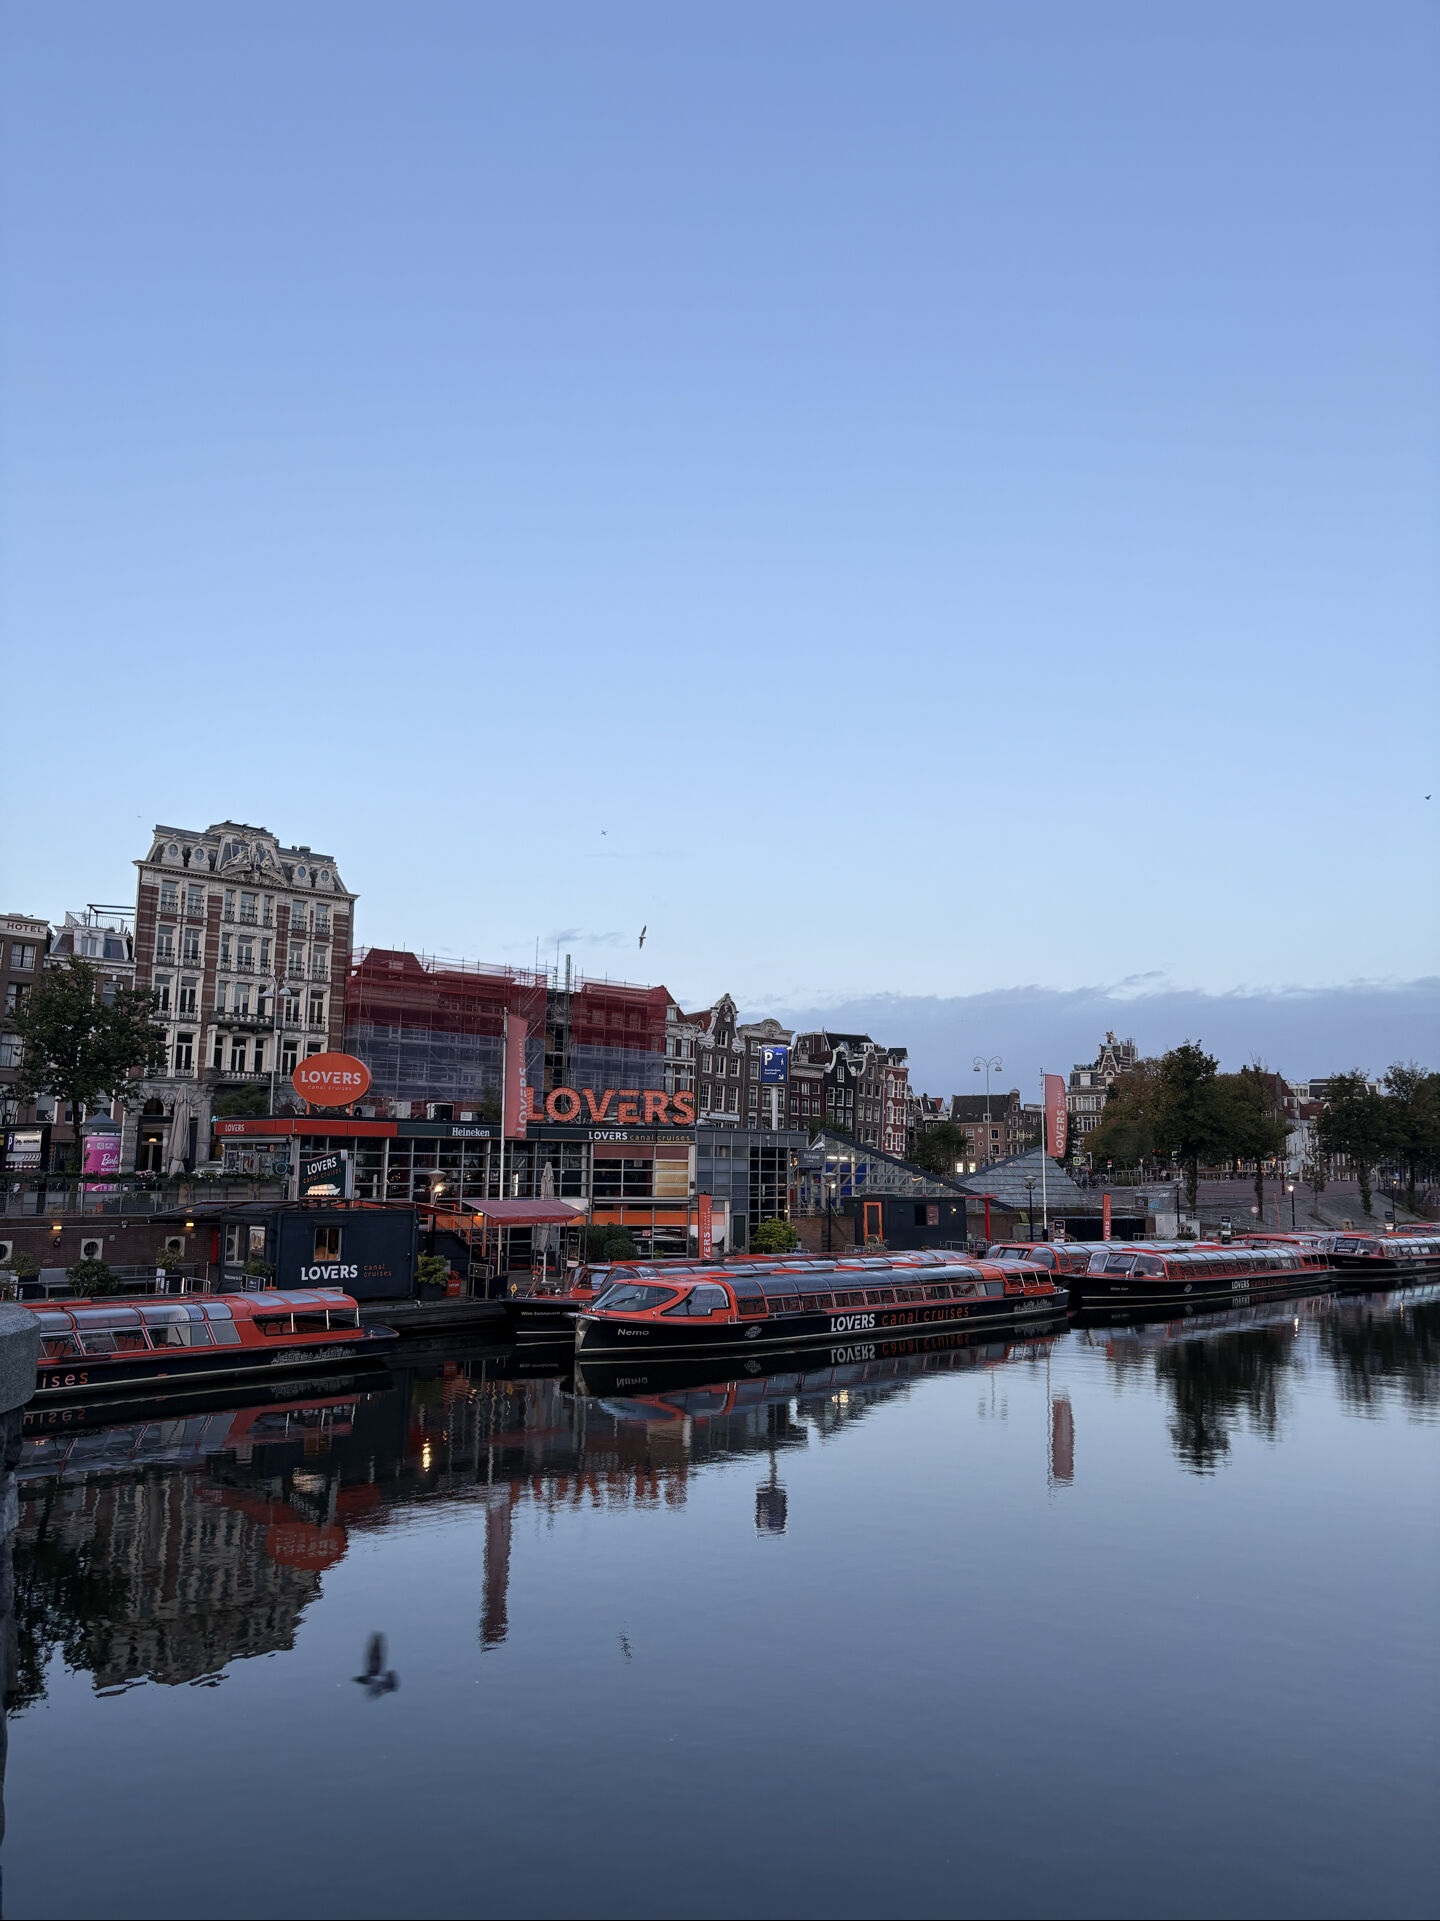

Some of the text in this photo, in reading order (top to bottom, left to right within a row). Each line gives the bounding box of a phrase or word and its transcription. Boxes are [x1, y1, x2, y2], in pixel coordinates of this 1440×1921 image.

[7, 922, 44, 934] HOTEL
[764, 1052, 774, 1066] P
[300, 1071, 362, 1086] LOVERS
[516, 1067, 528, 1133] LOVERS
[526, 1085, 697, 1126] LOVERS
[224, 1123, 245, 1132] LOVERS
[452, 1127, 490, 1137] Heineken
[1056, 1110, 1065, 1155] LOVERS
[588, 1131, 628, 1141] LOVERS
[629, 1133, 655, 1141] canal
[307, 1157, 337, 1175] LOVERS
[303, 1167, 342, 1184] canal cruises
[703, 1231, 711, 1258] VERS
[300, 1264, 359, 1281] LOVERS
[363, 1270, 392, 1278] cruises
[1231, 1279, 1250, 1290] LOVERS
[830, 1306, 970, 1333] LOVERS canal cruises
[617, 1328, 650, 1336] Nemo
[42, 1371, 89, 1389] ises
